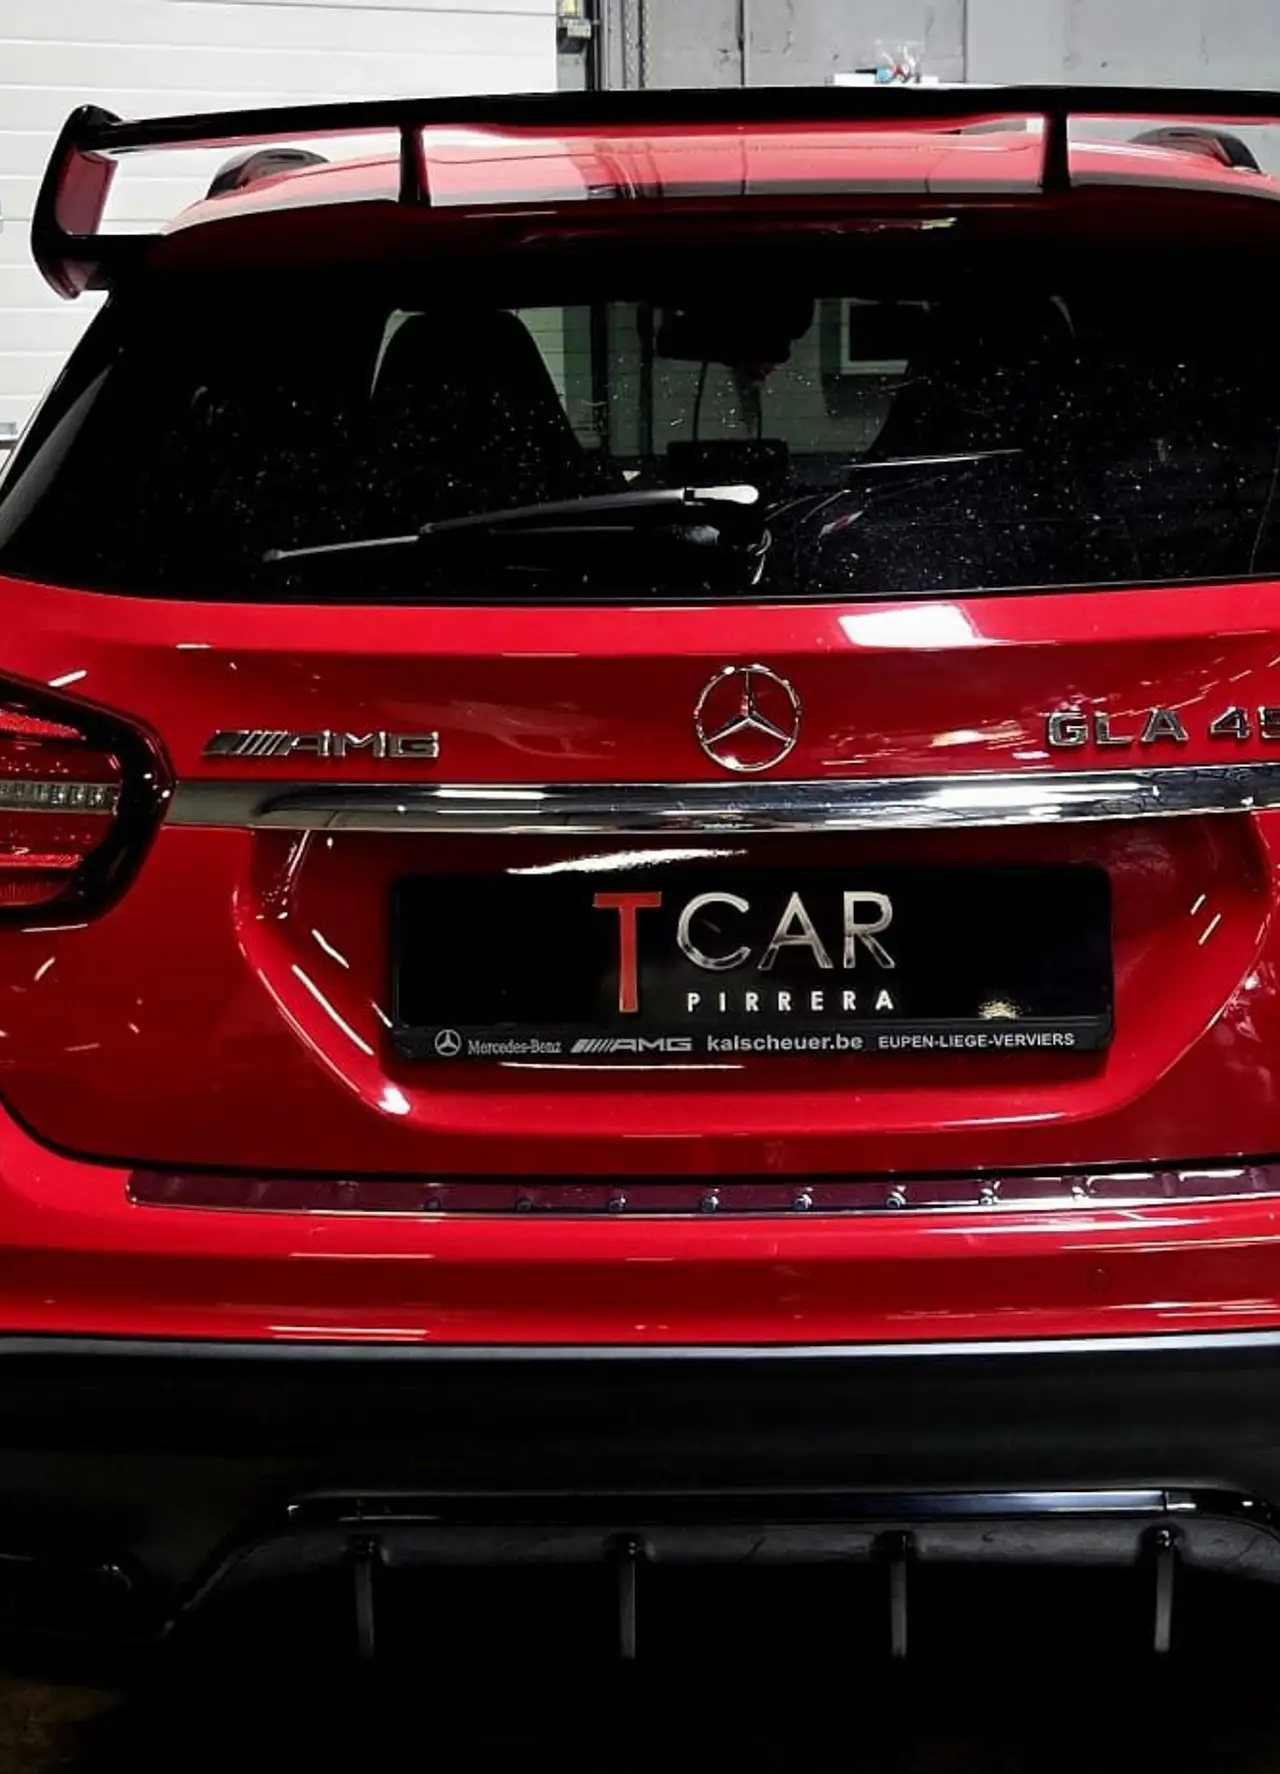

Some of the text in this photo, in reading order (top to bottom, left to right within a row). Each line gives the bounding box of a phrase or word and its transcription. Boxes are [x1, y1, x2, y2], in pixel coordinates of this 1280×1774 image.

[1048, 706, 1189, 746] GLA
[686, 990, 895, 1012] PIRRERA
[468, 1038, 562, 1055] Mercedes-Benz
[706, 1033, 864, 1052] kalscheuer.be
[877, 1032, 1075, 1049] EUPEN-LIEGE-VERVIERS
